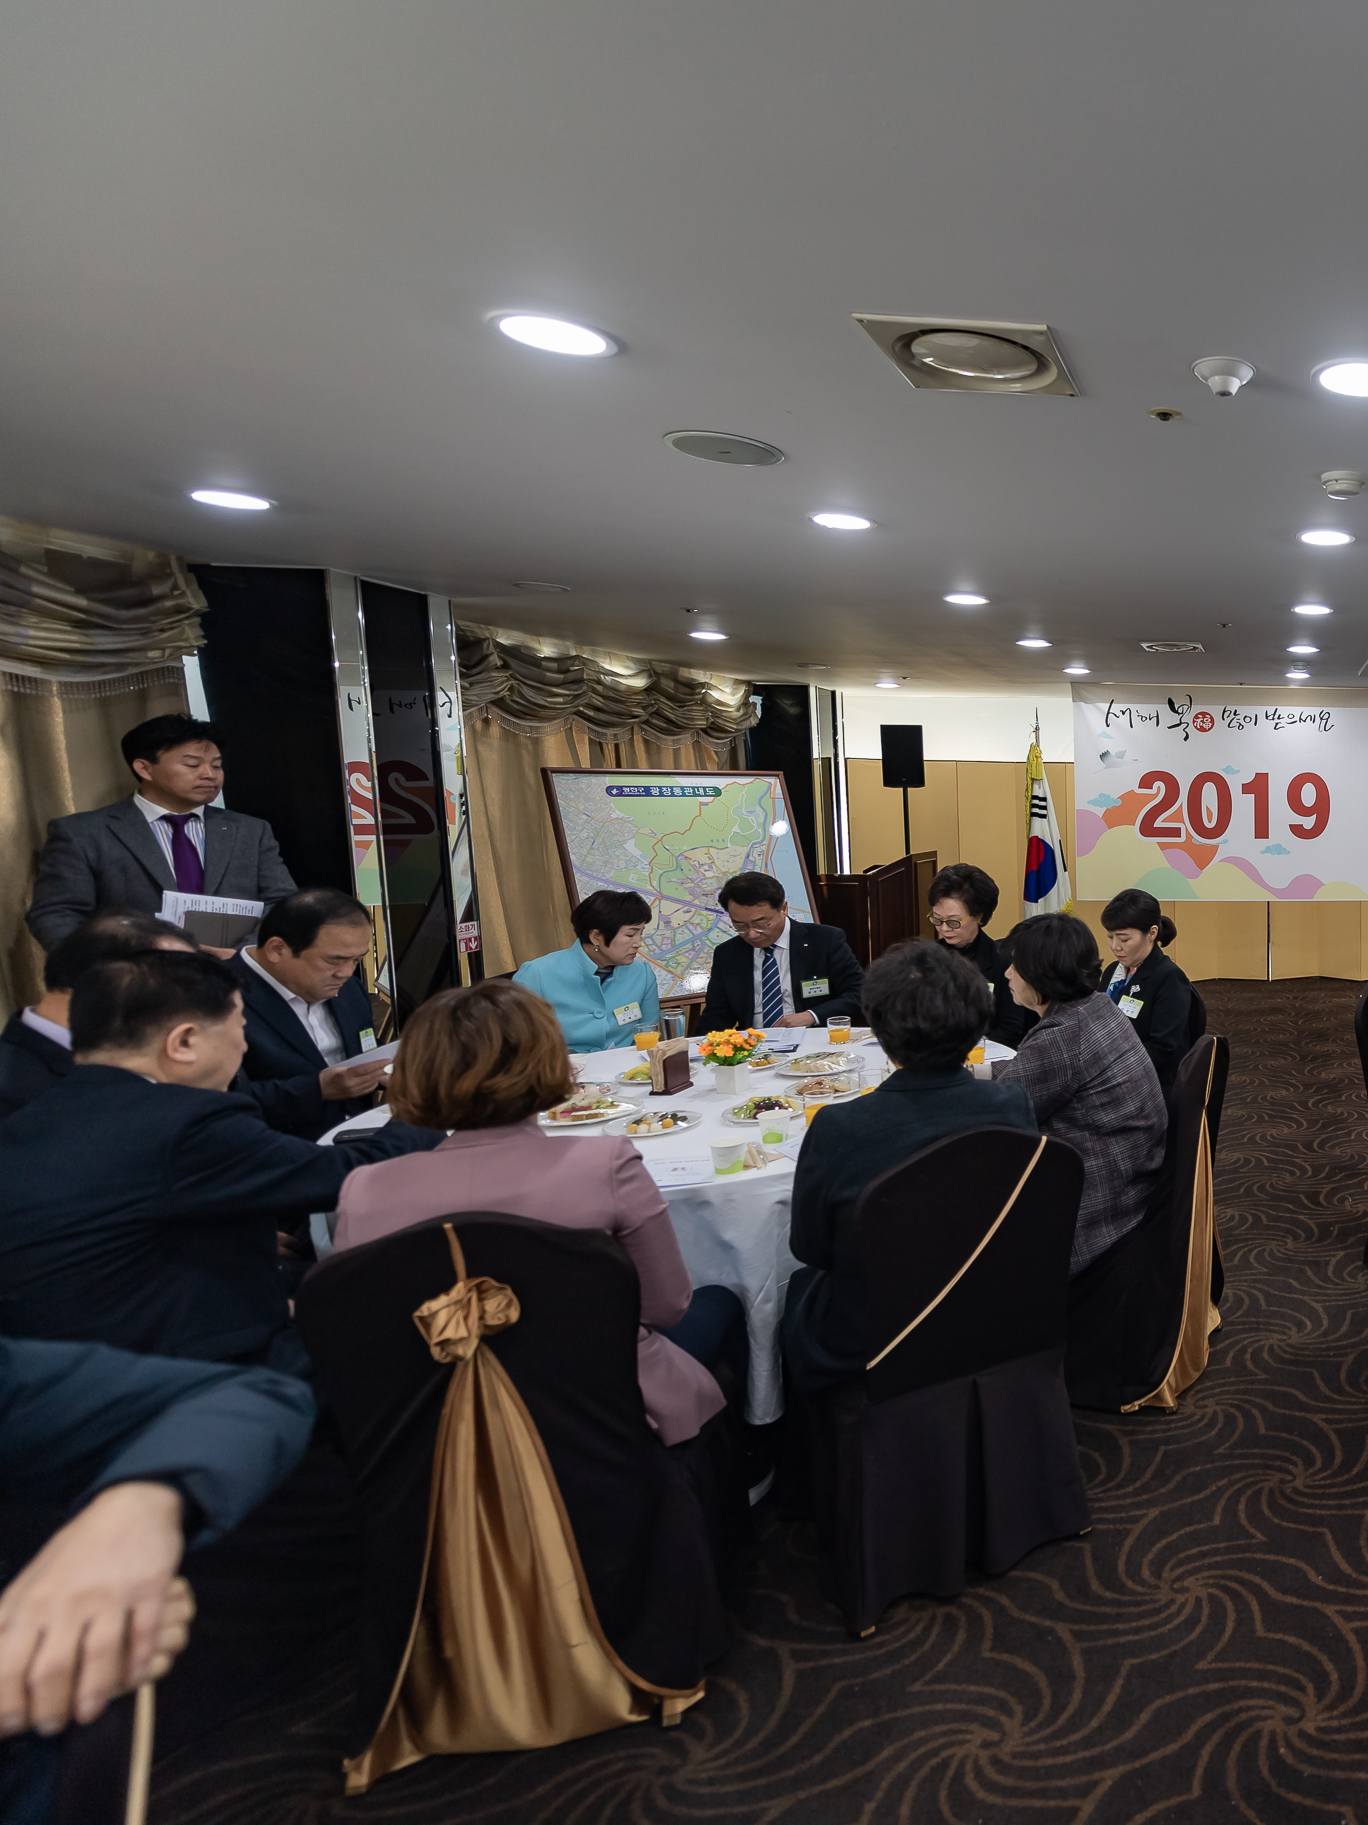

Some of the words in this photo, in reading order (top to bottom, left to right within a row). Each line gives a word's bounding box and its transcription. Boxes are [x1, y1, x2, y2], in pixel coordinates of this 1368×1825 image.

[1104, 698, 1160, 728] 새해
[1167, 694, 1192, 741] 복
[1221, 705, 1258, 730] 많이
[1265, 707, 1335, 732] 받으세요
[1137, 770, 1331, 840] 2019
